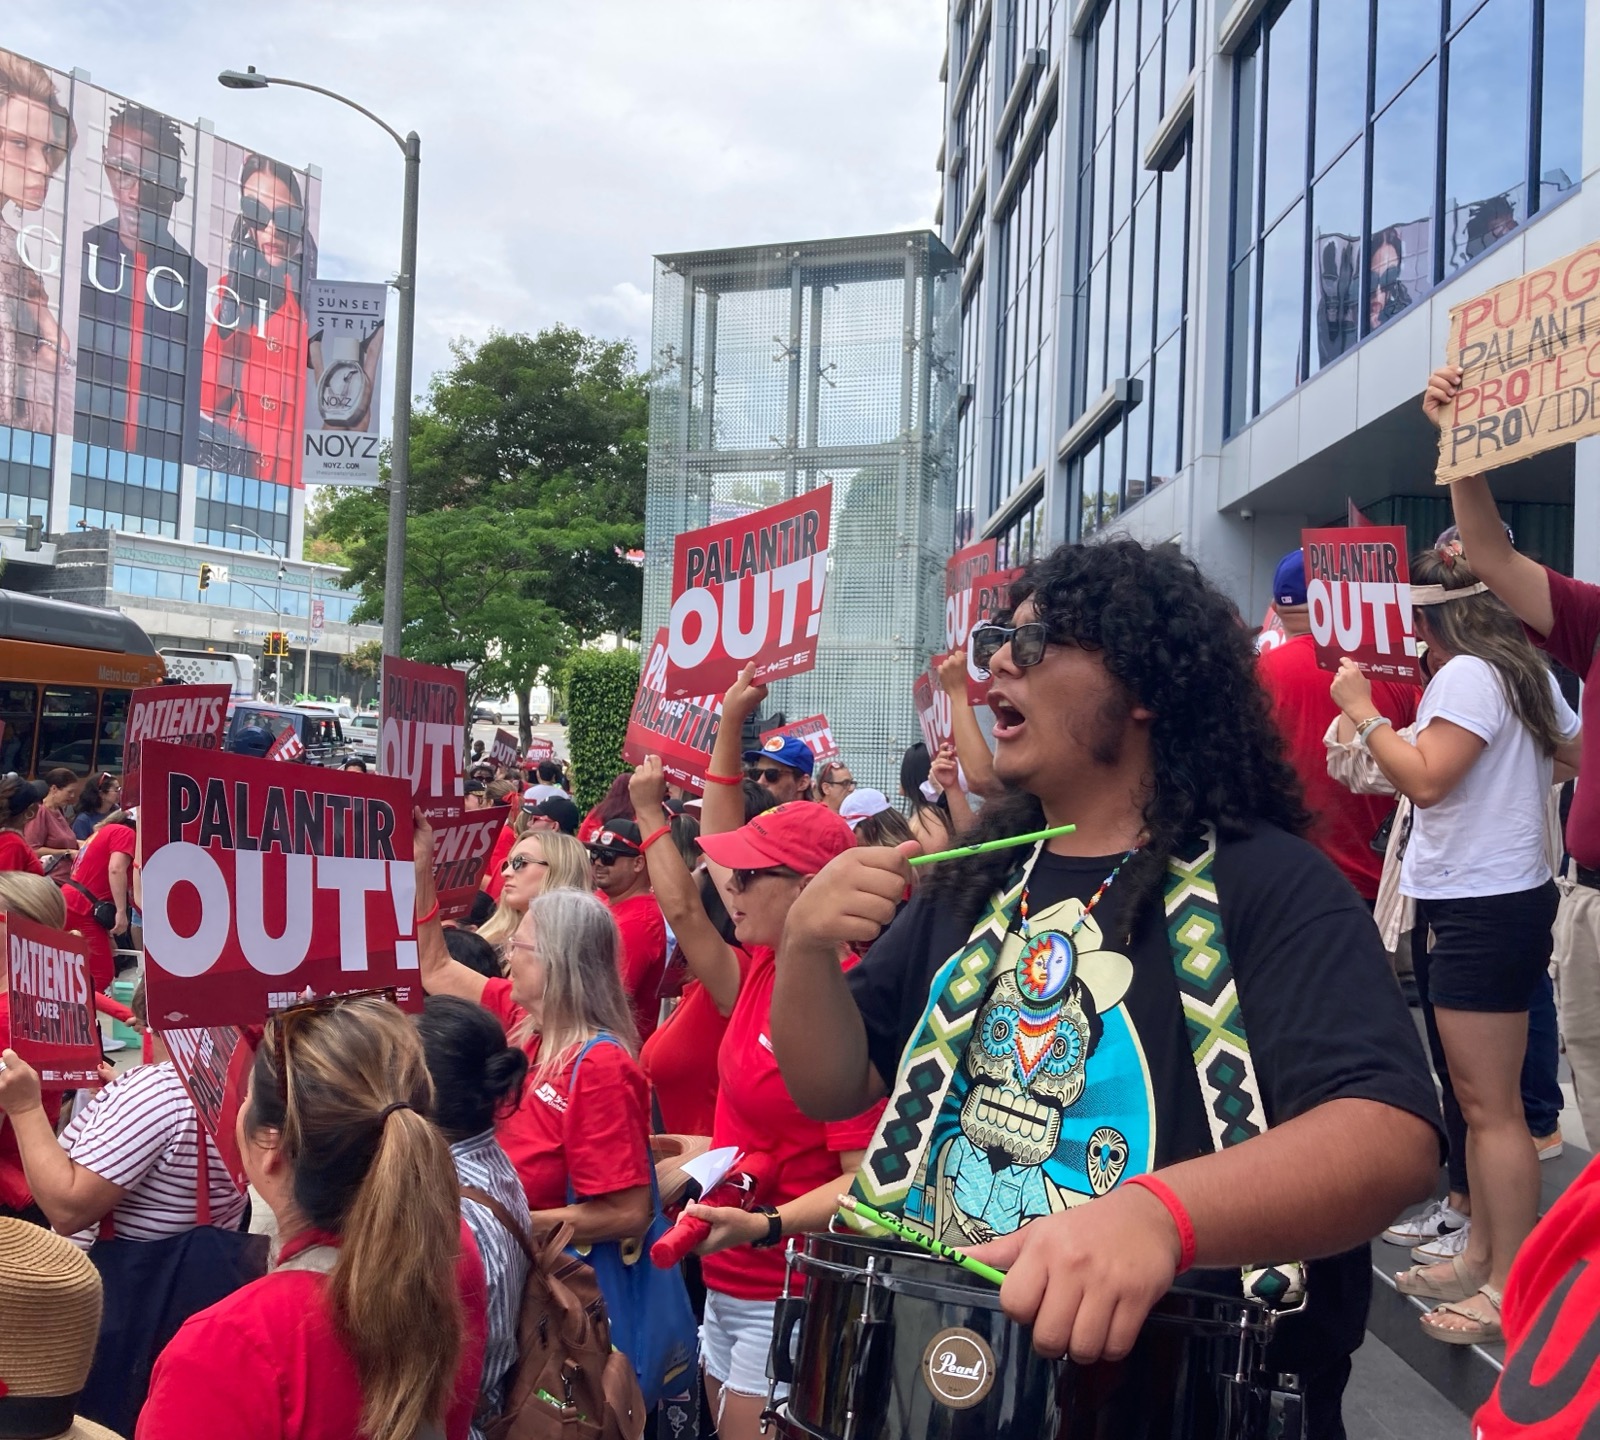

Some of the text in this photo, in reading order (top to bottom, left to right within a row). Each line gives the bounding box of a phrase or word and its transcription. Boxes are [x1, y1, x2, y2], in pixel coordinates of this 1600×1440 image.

[16, 224, 269, 338] GUCCI
[318, 298, 380, 310] SUNSET
[317, 317, 379, 330] STRIP
[1457, 297, 1600, 390] PALANT
[322, 396, 352, 408] NOYZ
[305, 434, 378, 459] NOYZ
[687, 509, 819, 590] PALANTIR
[1310, 542, 1400, 583] PALANTIR
[667, 550, 828, 670] OUT!
[1307, 578, 1417, 657] OUT!
[98, 665, 140, 683] Metro Local
[388, 674, 458, 725] PALANTIR
[129, 697, 222, 743] PATIENTS
[632, 685, 722, 756] PALANTIR
[658, 701, 685, 719] OVER
[382, 717, 465, 797] OUT!
[168, 772, 397, 861] PALANTIR
[142, 841, 419, 978] OUT!
[10, 934, 88, 1005] PATIENTS
[12, 990, 95, 1046] PALANTIR
[36, 1000, 60, 1020] OVER
[932, 1351, 982, 1377] Pearl
